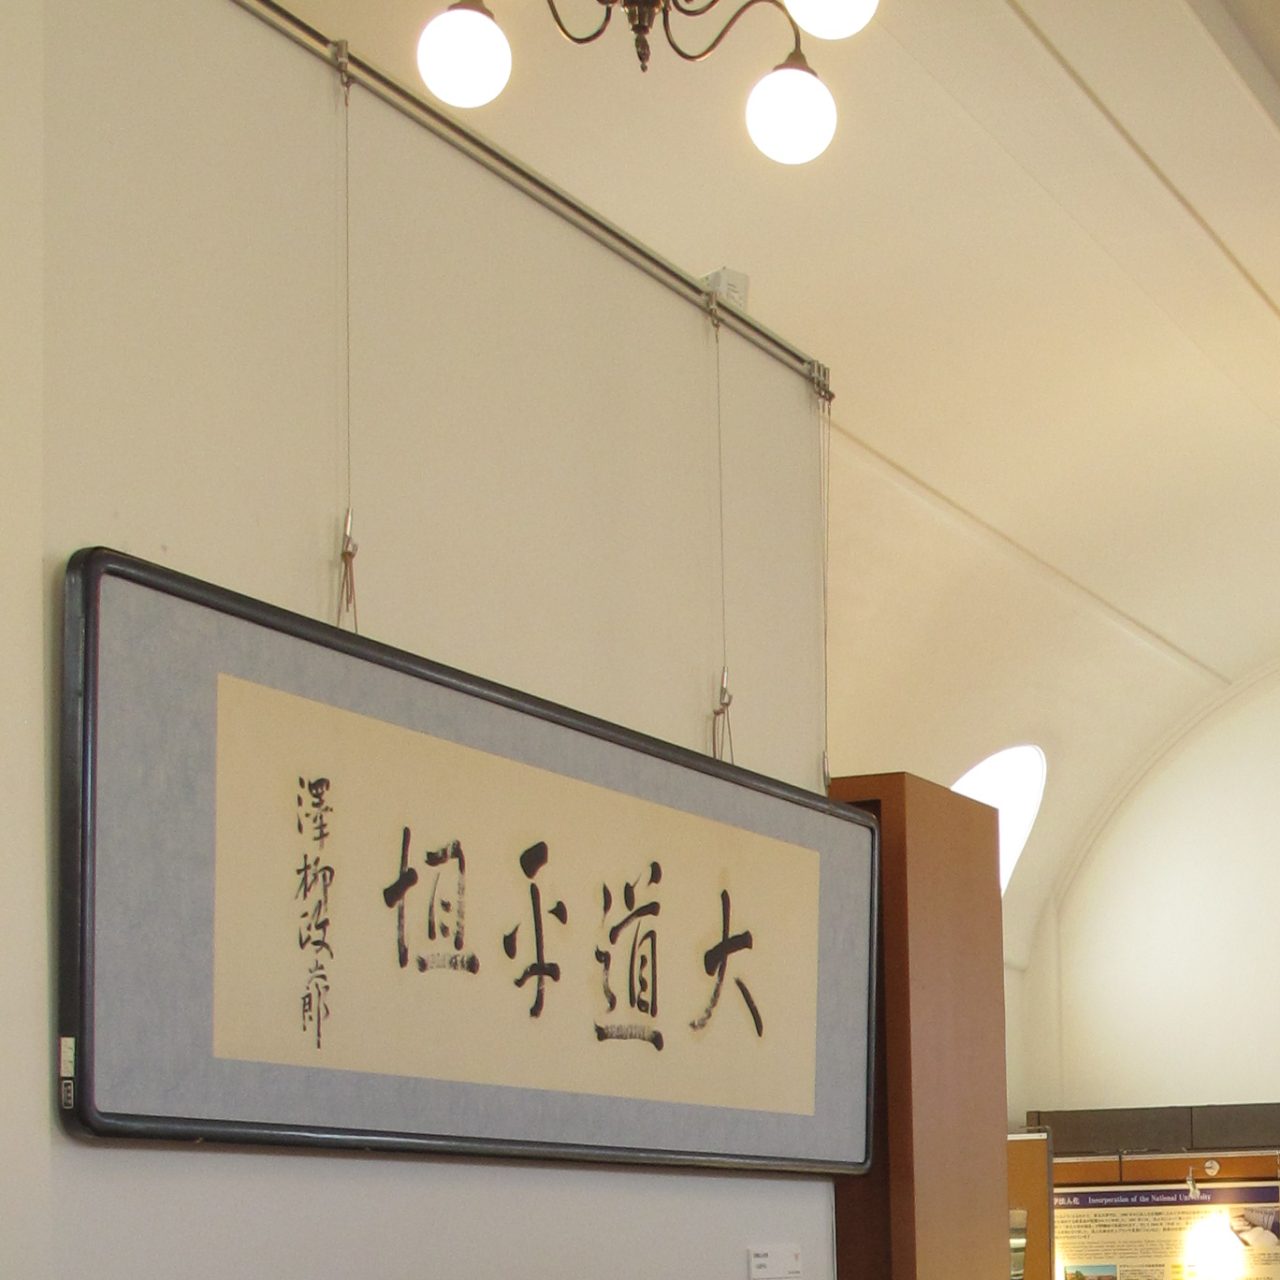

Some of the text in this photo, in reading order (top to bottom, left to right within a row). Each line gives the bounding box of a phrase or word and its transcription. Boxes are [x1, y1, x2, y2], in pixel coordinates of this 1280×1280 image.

[1089, 1196, 1128, 1205] Incorporation
[1130, 1195, 1137, 1203] of
[1139, 1195, 1149, 1203] the
[1151, 1194, 1177, 1202] National
